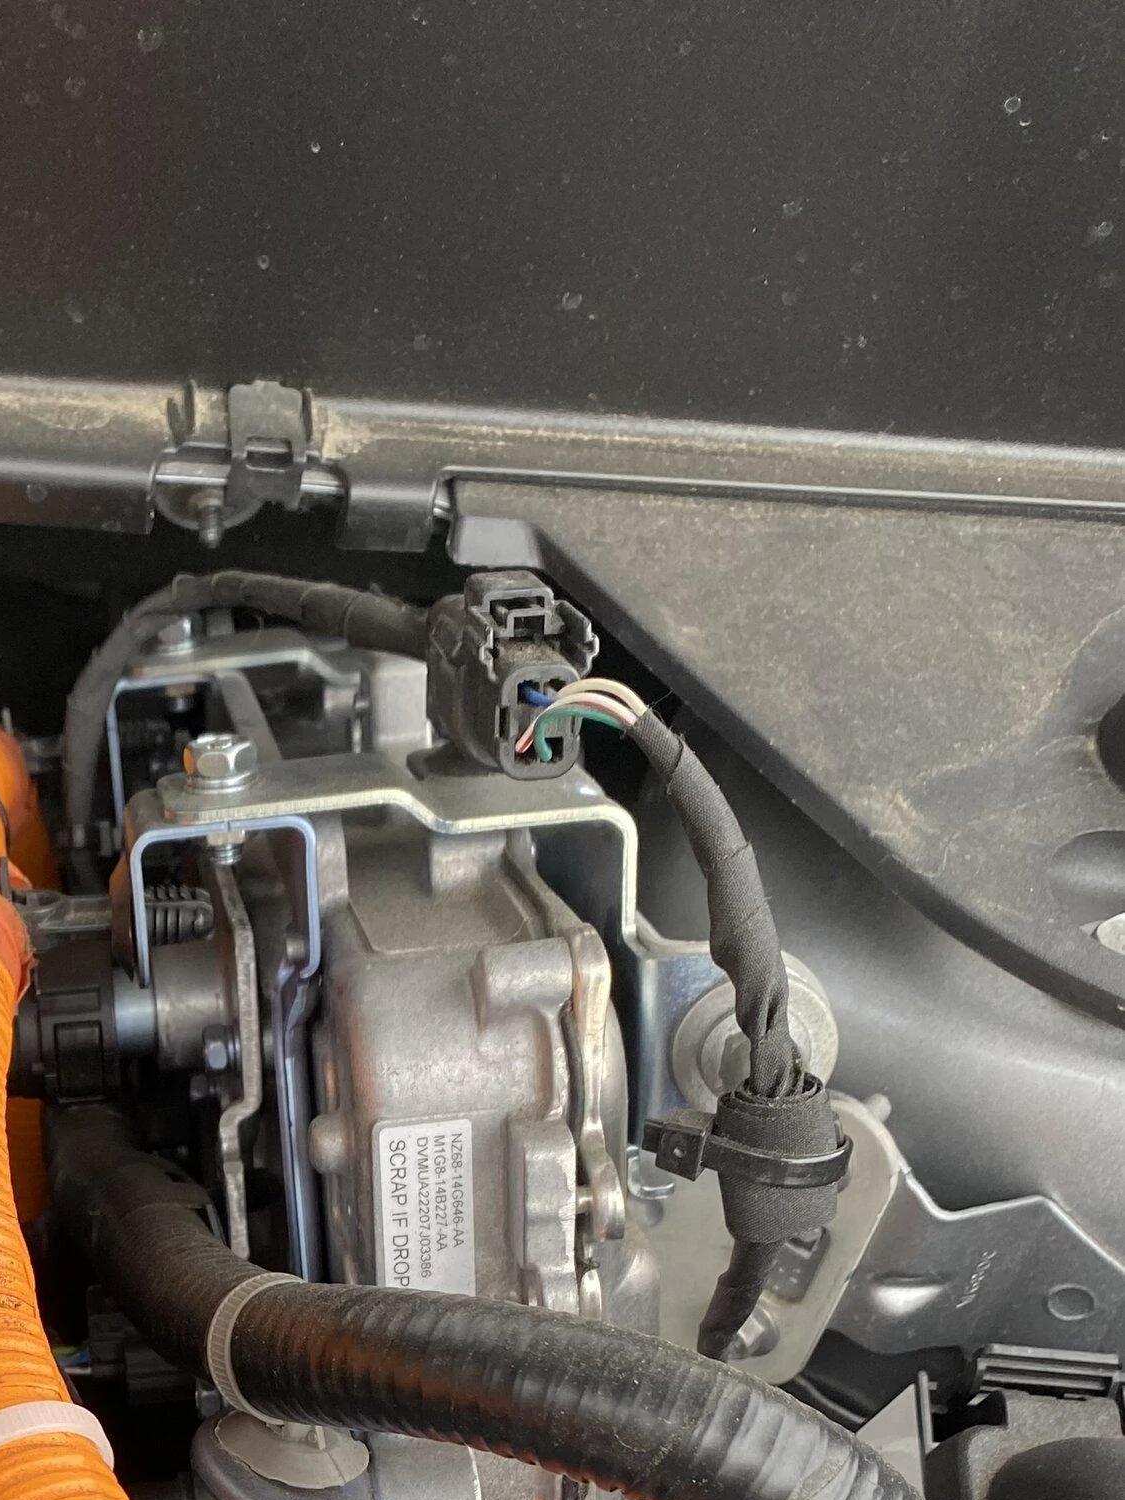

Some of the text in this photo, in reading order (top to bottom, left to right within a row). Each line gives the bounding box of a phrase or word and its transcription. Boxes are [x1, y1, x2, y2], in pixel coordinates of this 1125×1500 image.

[389, 1140, 410, 1287] SCRAP IF DROP
[434, 1135, 448, 1251] M1G8-14B227-AA
[451, 1133, 464, 1248] NZ68-14G646-AA
